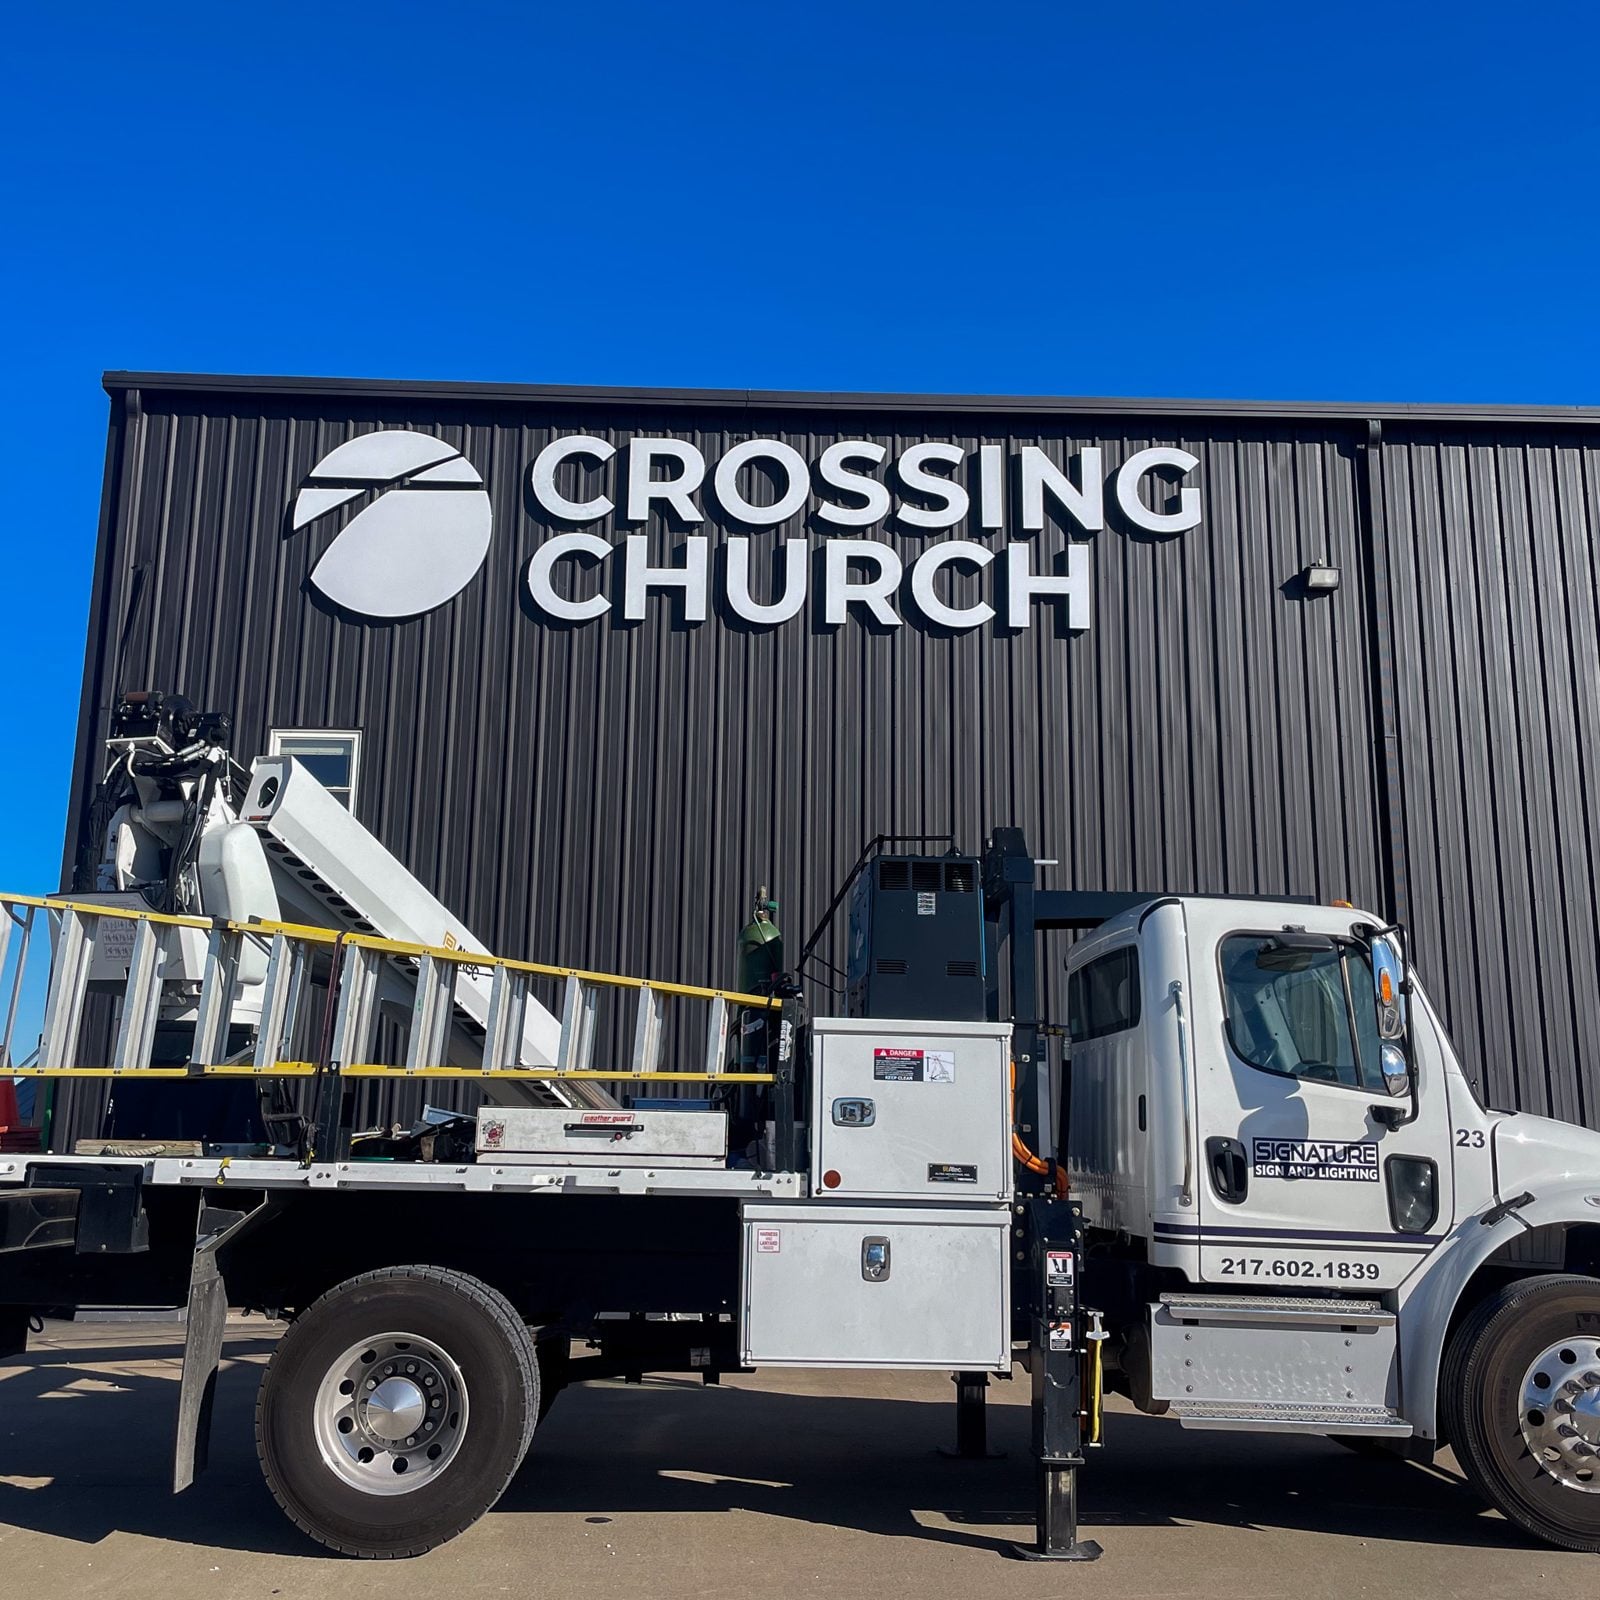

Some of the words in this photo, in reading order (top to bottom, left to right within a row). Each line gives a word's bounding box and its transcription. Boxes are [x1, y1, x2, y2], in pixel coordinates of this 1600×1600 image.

[531, 434, 1202, 534] CROSSING
[528, 535, 1091, 630] CHURCH
[889, 1049, 918, 1057] DANGER
[612, 1115, 632, 1123] guard
[1455, 1128, 1486, 1149] 23
[1256, 1141, 1377, 1165] SIGNATURE
[1255, 1164, 1285, 1176] SIGN
[1287, 1165, 1316, 1178] AND
[1318, 1166, 1378, 1180] LIGHTING
[1221, 1257, 1380, 1280] 217.602.1839
